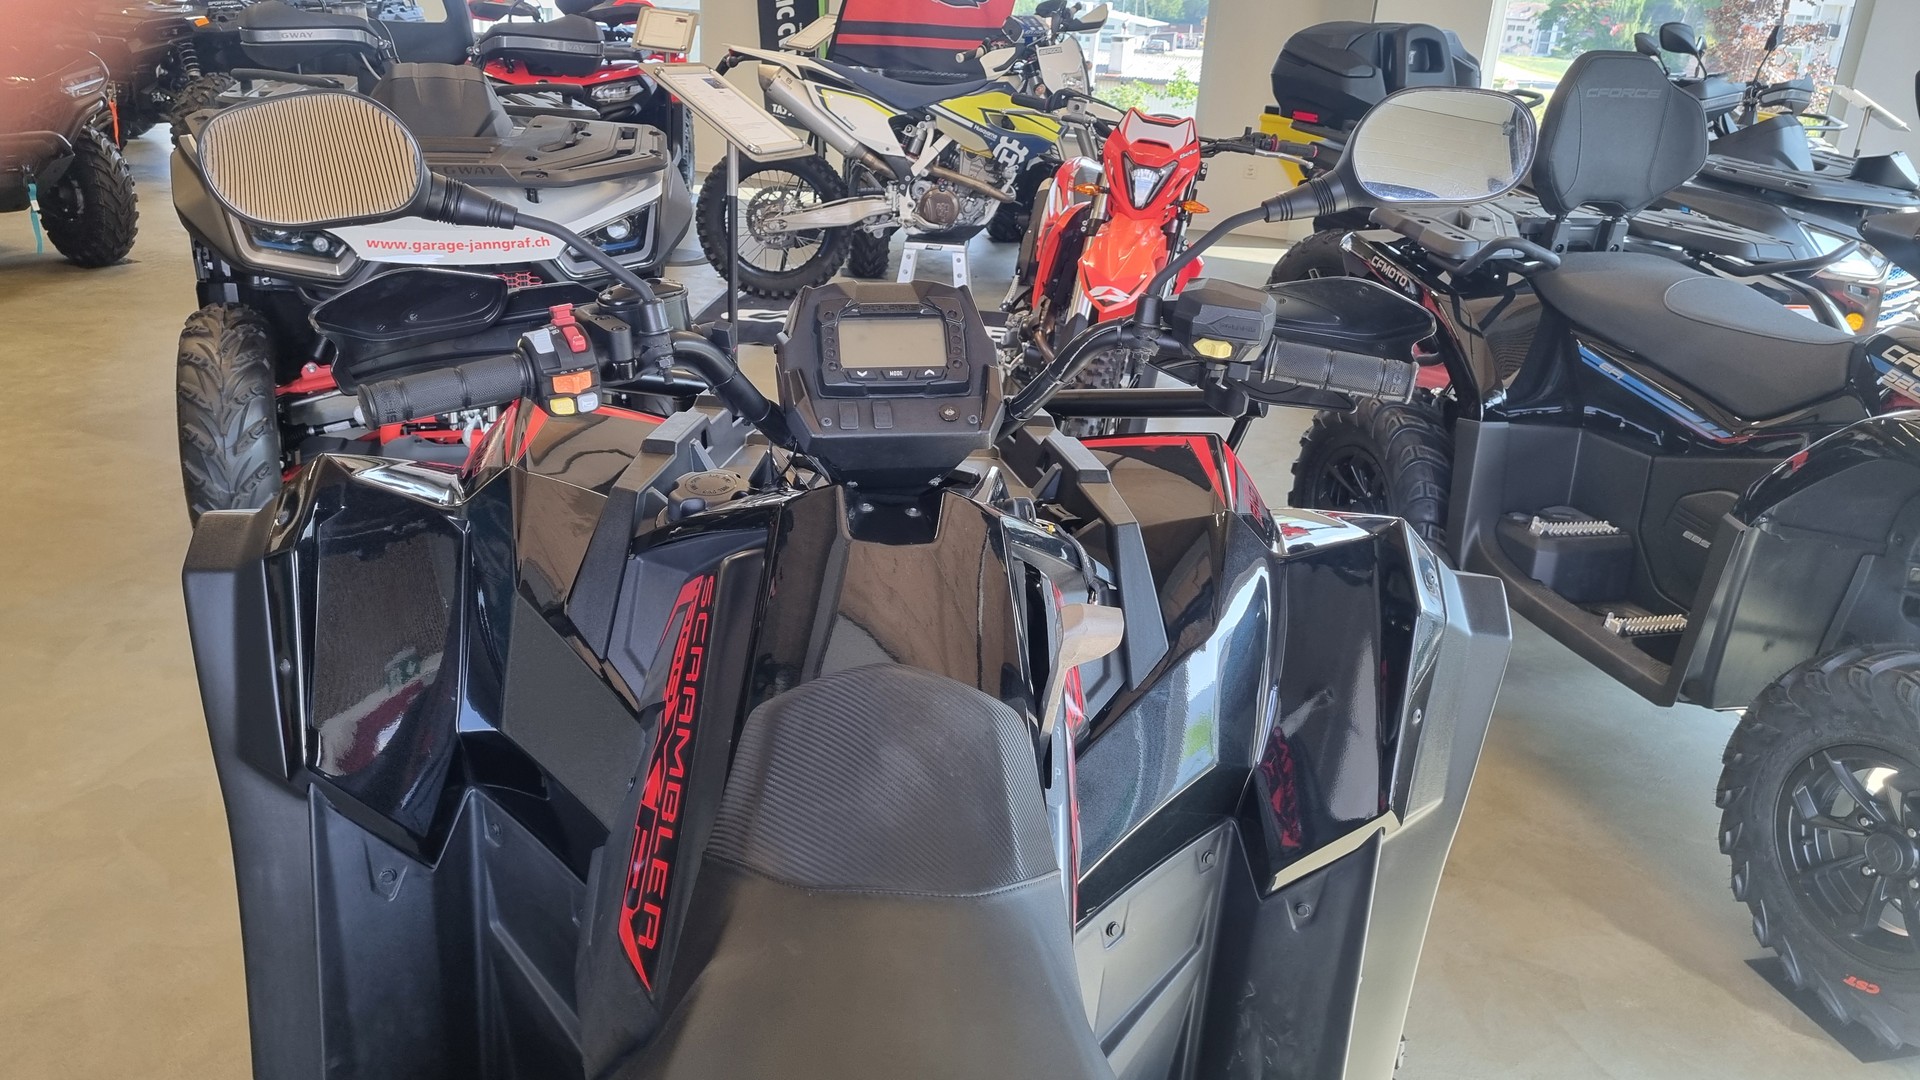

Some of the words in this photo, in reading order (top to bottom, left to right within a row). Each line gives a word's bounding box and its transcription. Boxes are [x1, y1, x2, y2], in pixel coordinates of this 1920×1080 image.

[1586, 87, 1661, 98] CFORCE
[366, 236, 551, 253] www.garage-janngraf.ch
[1371, 255, 1408, 287] CFMOTO
[637, 574, 716, 951] SCRAMBLER
[1843, 975, 1880, 994] CST
